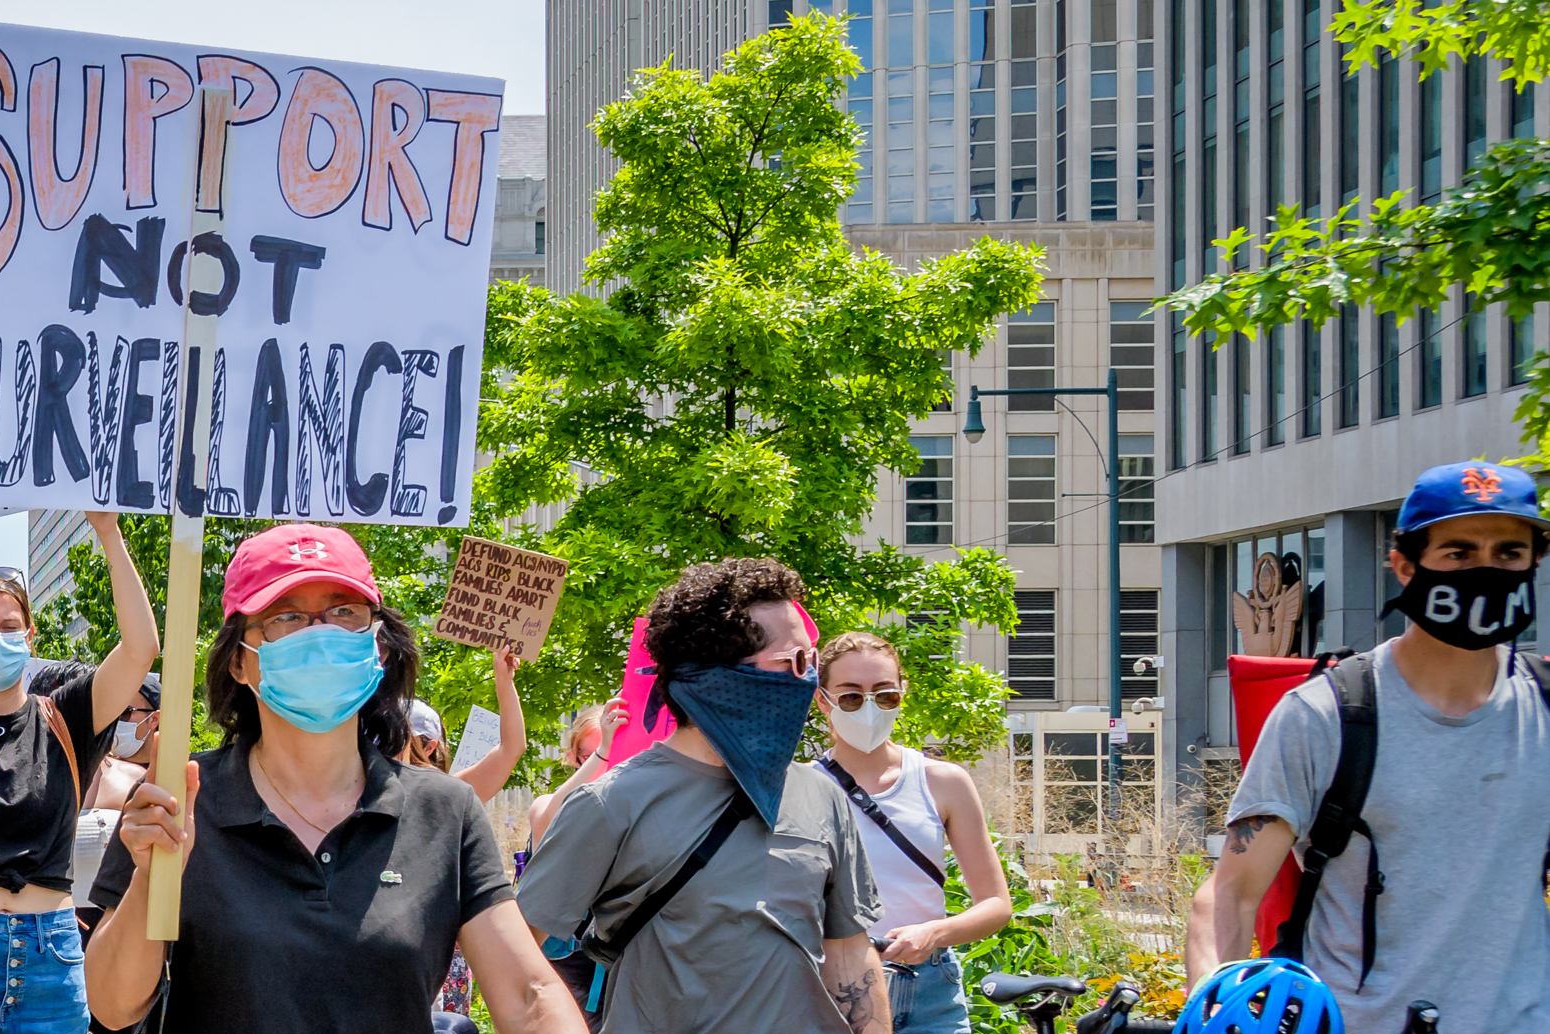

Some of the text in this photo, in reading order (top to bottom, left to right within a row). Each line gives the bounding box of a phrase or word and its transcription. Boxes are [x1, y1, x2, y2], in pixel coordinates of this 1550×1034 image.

[69, 214, 327, 325] NOT
[457, 556, 556, 594] ACS RIPS BLACK
[461, 539, 567, 577] DEFUND ACS/NYPD
[446, 586, 522, 621] FUND BLACK
[451, 569, 548, 611] FAMILIES APART
[1425, 582, 1531, 636] BLM
[441, 601, 496, 630] FAMILIES
[436, 617, 525, 655] COMMUNITIES
[479, 731, 501, 747] BLAC
